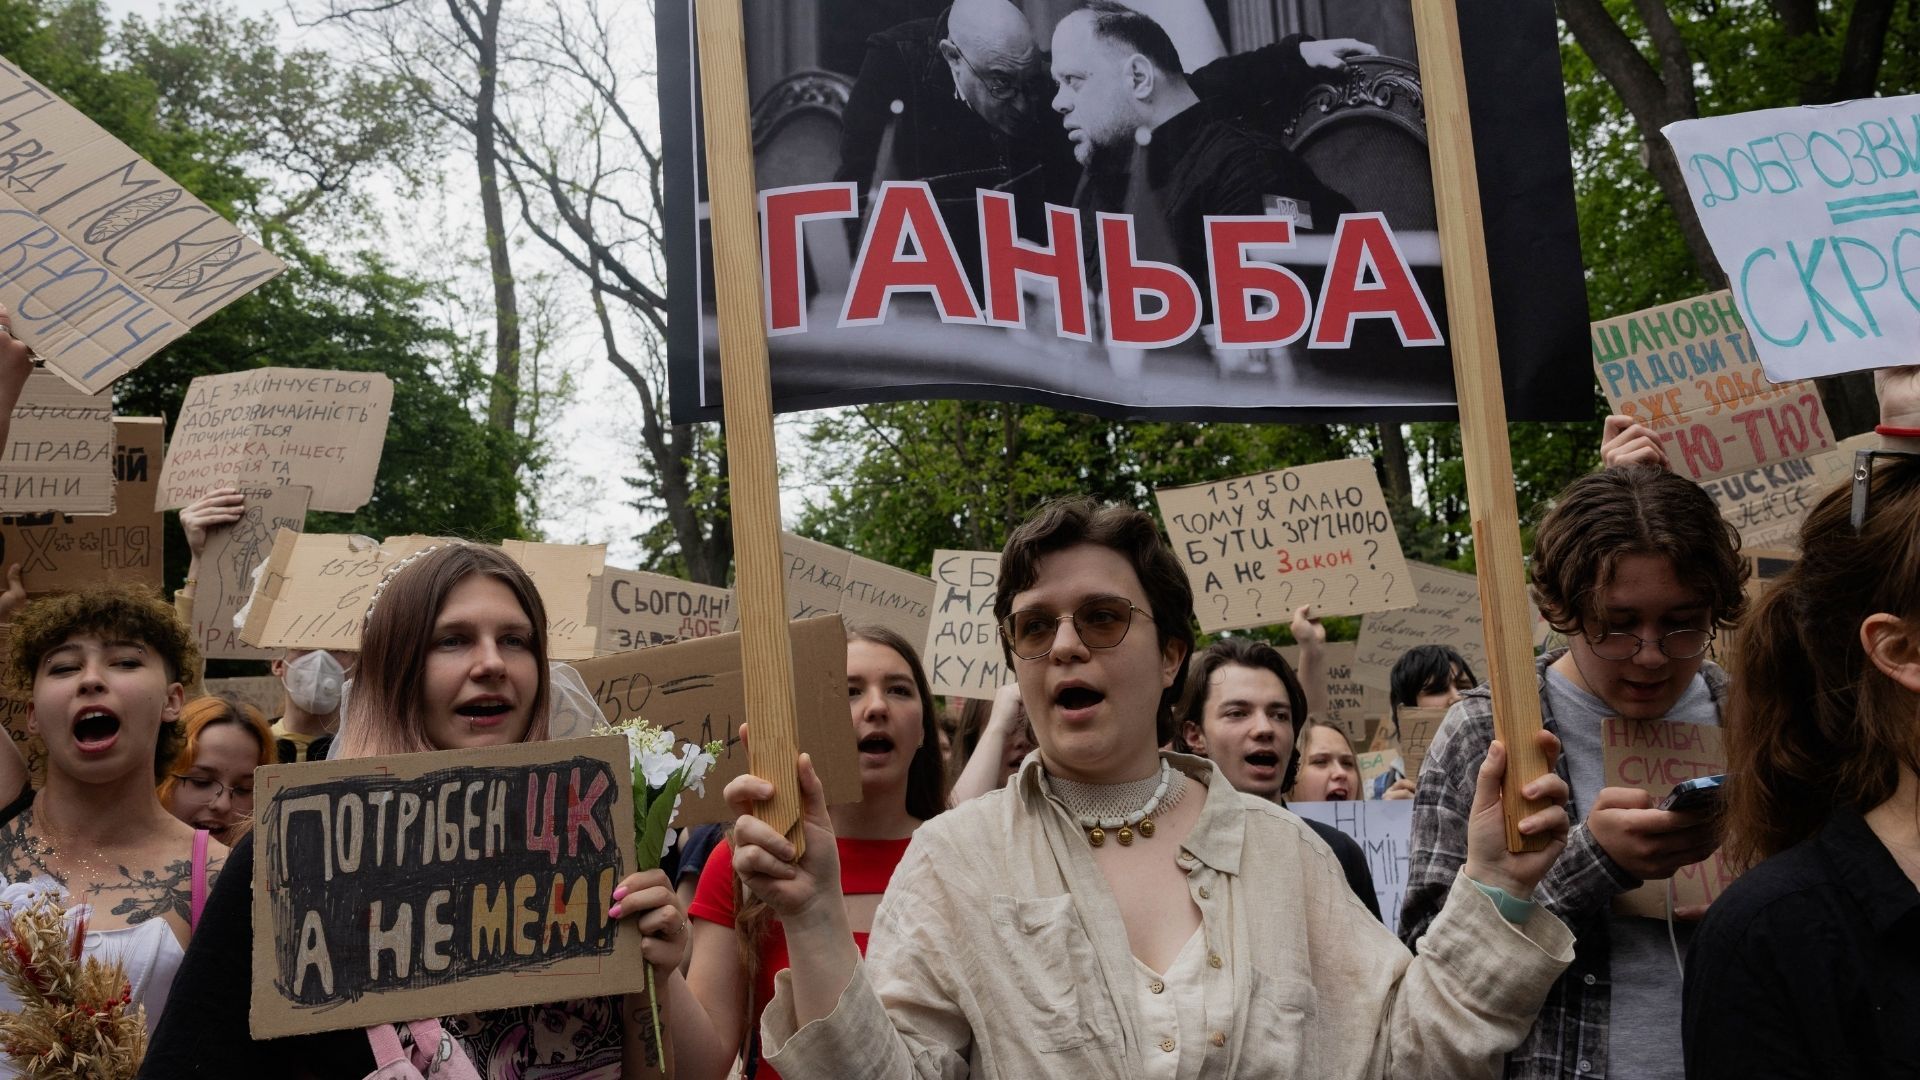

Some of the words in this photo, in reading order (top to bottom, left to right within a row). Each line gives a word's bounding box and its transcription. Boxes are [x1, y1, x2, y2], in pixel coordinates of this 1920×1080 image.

[38, 158, 278, 320] МОСКВИ
[760, 180, 1445, 350] ГАНЬБА
[1601, 339, 1727, 398] РАДОВИ
[1695, 367, 1806, 417] ЗОВС
[186, 386, 224, 412] ДЕ
[232, 374, 371, 401] ЗАКІНЧУЄТЬСЯ
[12, 440, 109, 462] ПРАВА
[187, 424, 292, 444] ПОЧИНАЄТЬСЯ
[1659, 393, 1828, 479] Ю-ТЮ?
[271, 461, 290, 475] ТА
[1207, 471, 1300, 505] 15150
[1257, 499, 1275, 521] Я
[1289, 486, 1363, 515] МАЮ
[1186, 528, 1273, 565] БУТИ
[1282, 510, 1388, 544] ЗРУЧНОЮ
[784, 552, 929, 618] РАЖДАТИМУТЬ
[939, 556, 998, 588] ЄБ
[1205, 571, 1222, 593] А
[1277, 549, 1353, 574] Закон
[610, 579, 730, 619] СЬОГОДНІ
[280, 779, 509, 883] ПОТРІБЕН
[525, 766, 610, 865] ЦК
[293, 910, 334, 998] А
[368, 889, 454, 982] НЕ
